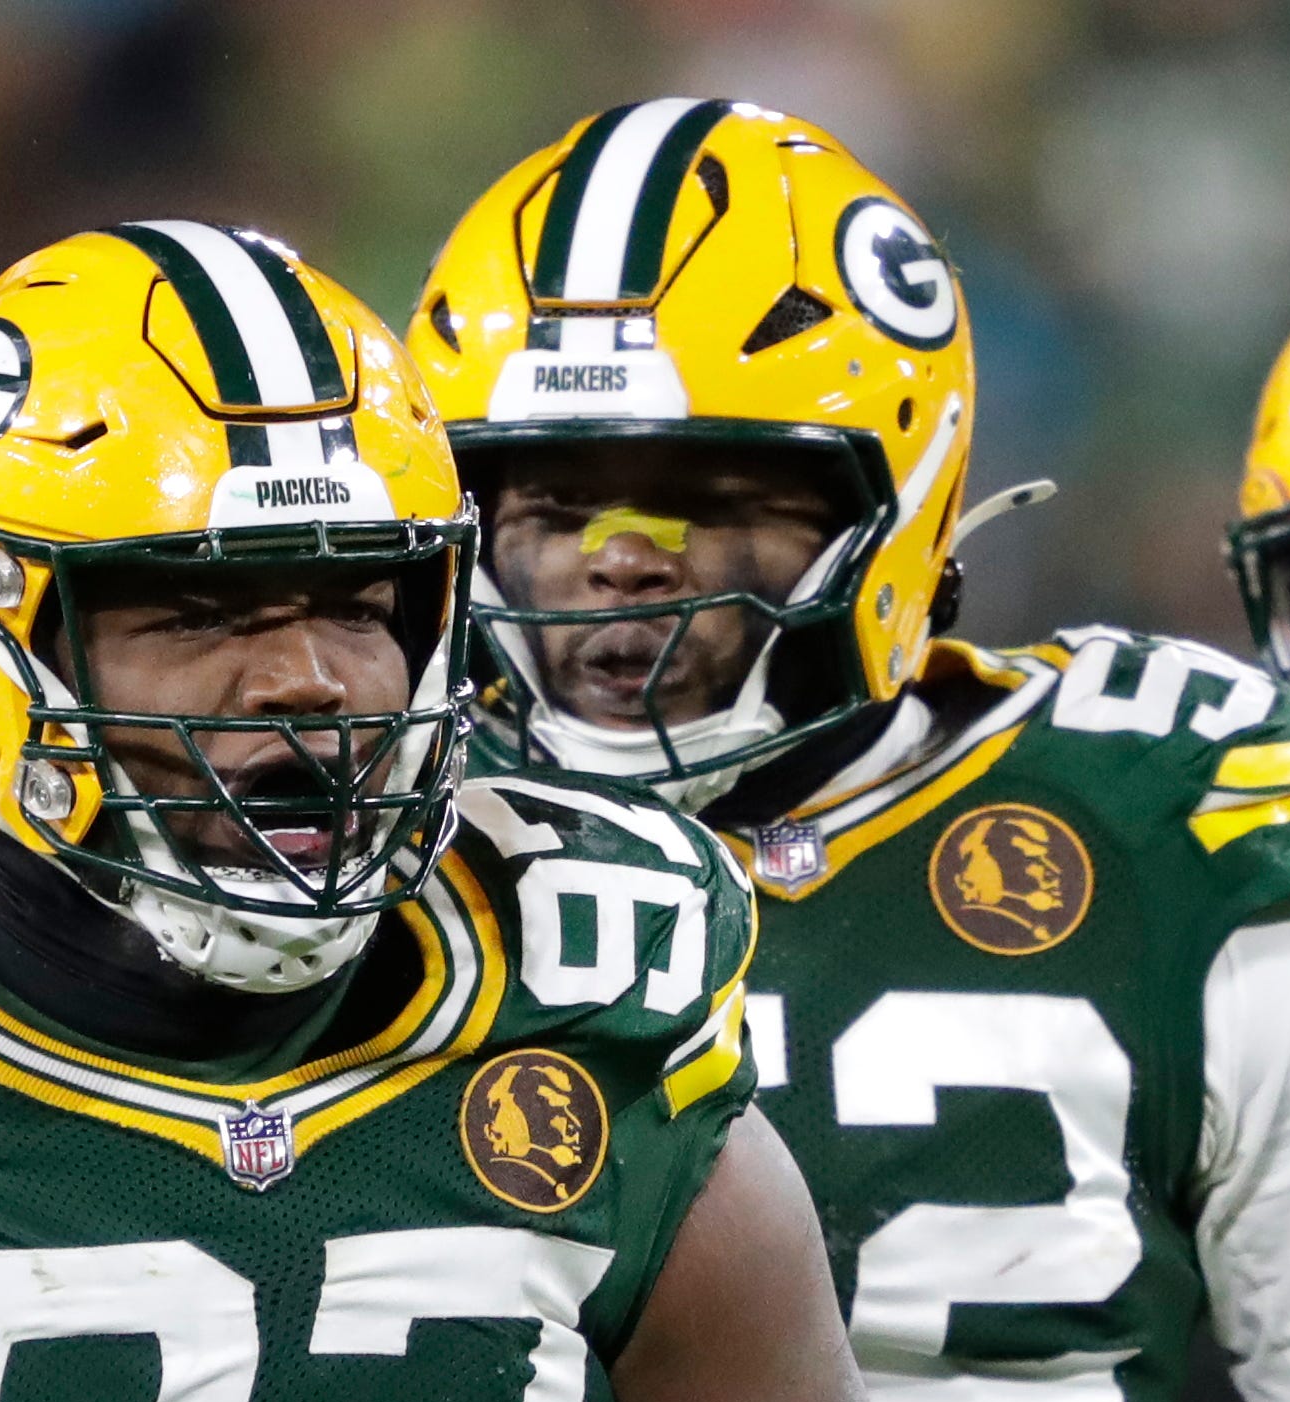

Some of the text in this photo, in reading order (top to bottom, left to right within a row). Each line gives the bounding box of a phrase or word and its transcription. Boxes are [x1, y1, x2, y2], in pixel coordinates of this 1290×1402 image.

[842, 204, 956, 339] G
[534, 364, 628, 393] PACKERS
[255, 476, 351, 508] PACKERS
[765, 843, 813, 875] NFL
[454, 776, 709, 1016] 97
[235, 1139, 284, 1175] NFL
